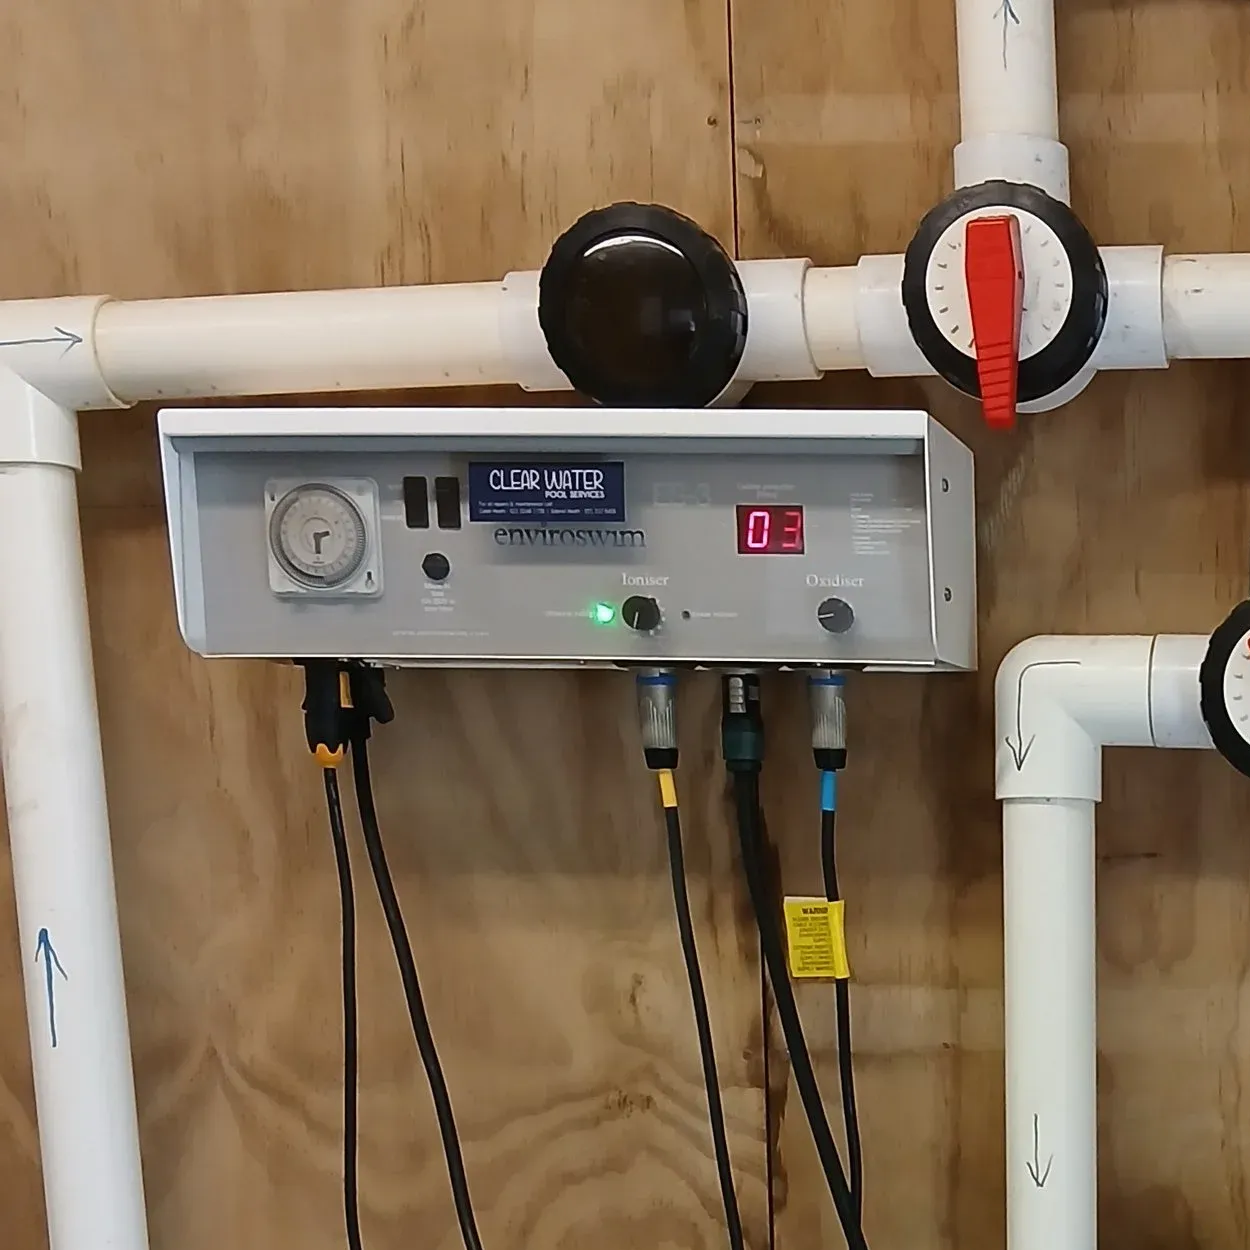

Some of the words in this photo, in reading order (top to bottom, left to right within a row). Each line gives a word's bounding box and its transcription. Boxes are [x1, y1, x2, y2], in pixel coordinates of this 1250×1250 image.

[489, 468, 540, 491] CLEAR
[543, 468, 604, 491] WATER
[544, 490, 568, 499] POOL
[569, 490, 605, 499] SERVICES
[494, 522, 648, 548] enviroswim
[746, 511, 802, 548] 03
[622, 572, 670, 587] Ioniser
[806, 574, 865, 588] Oxidiser
